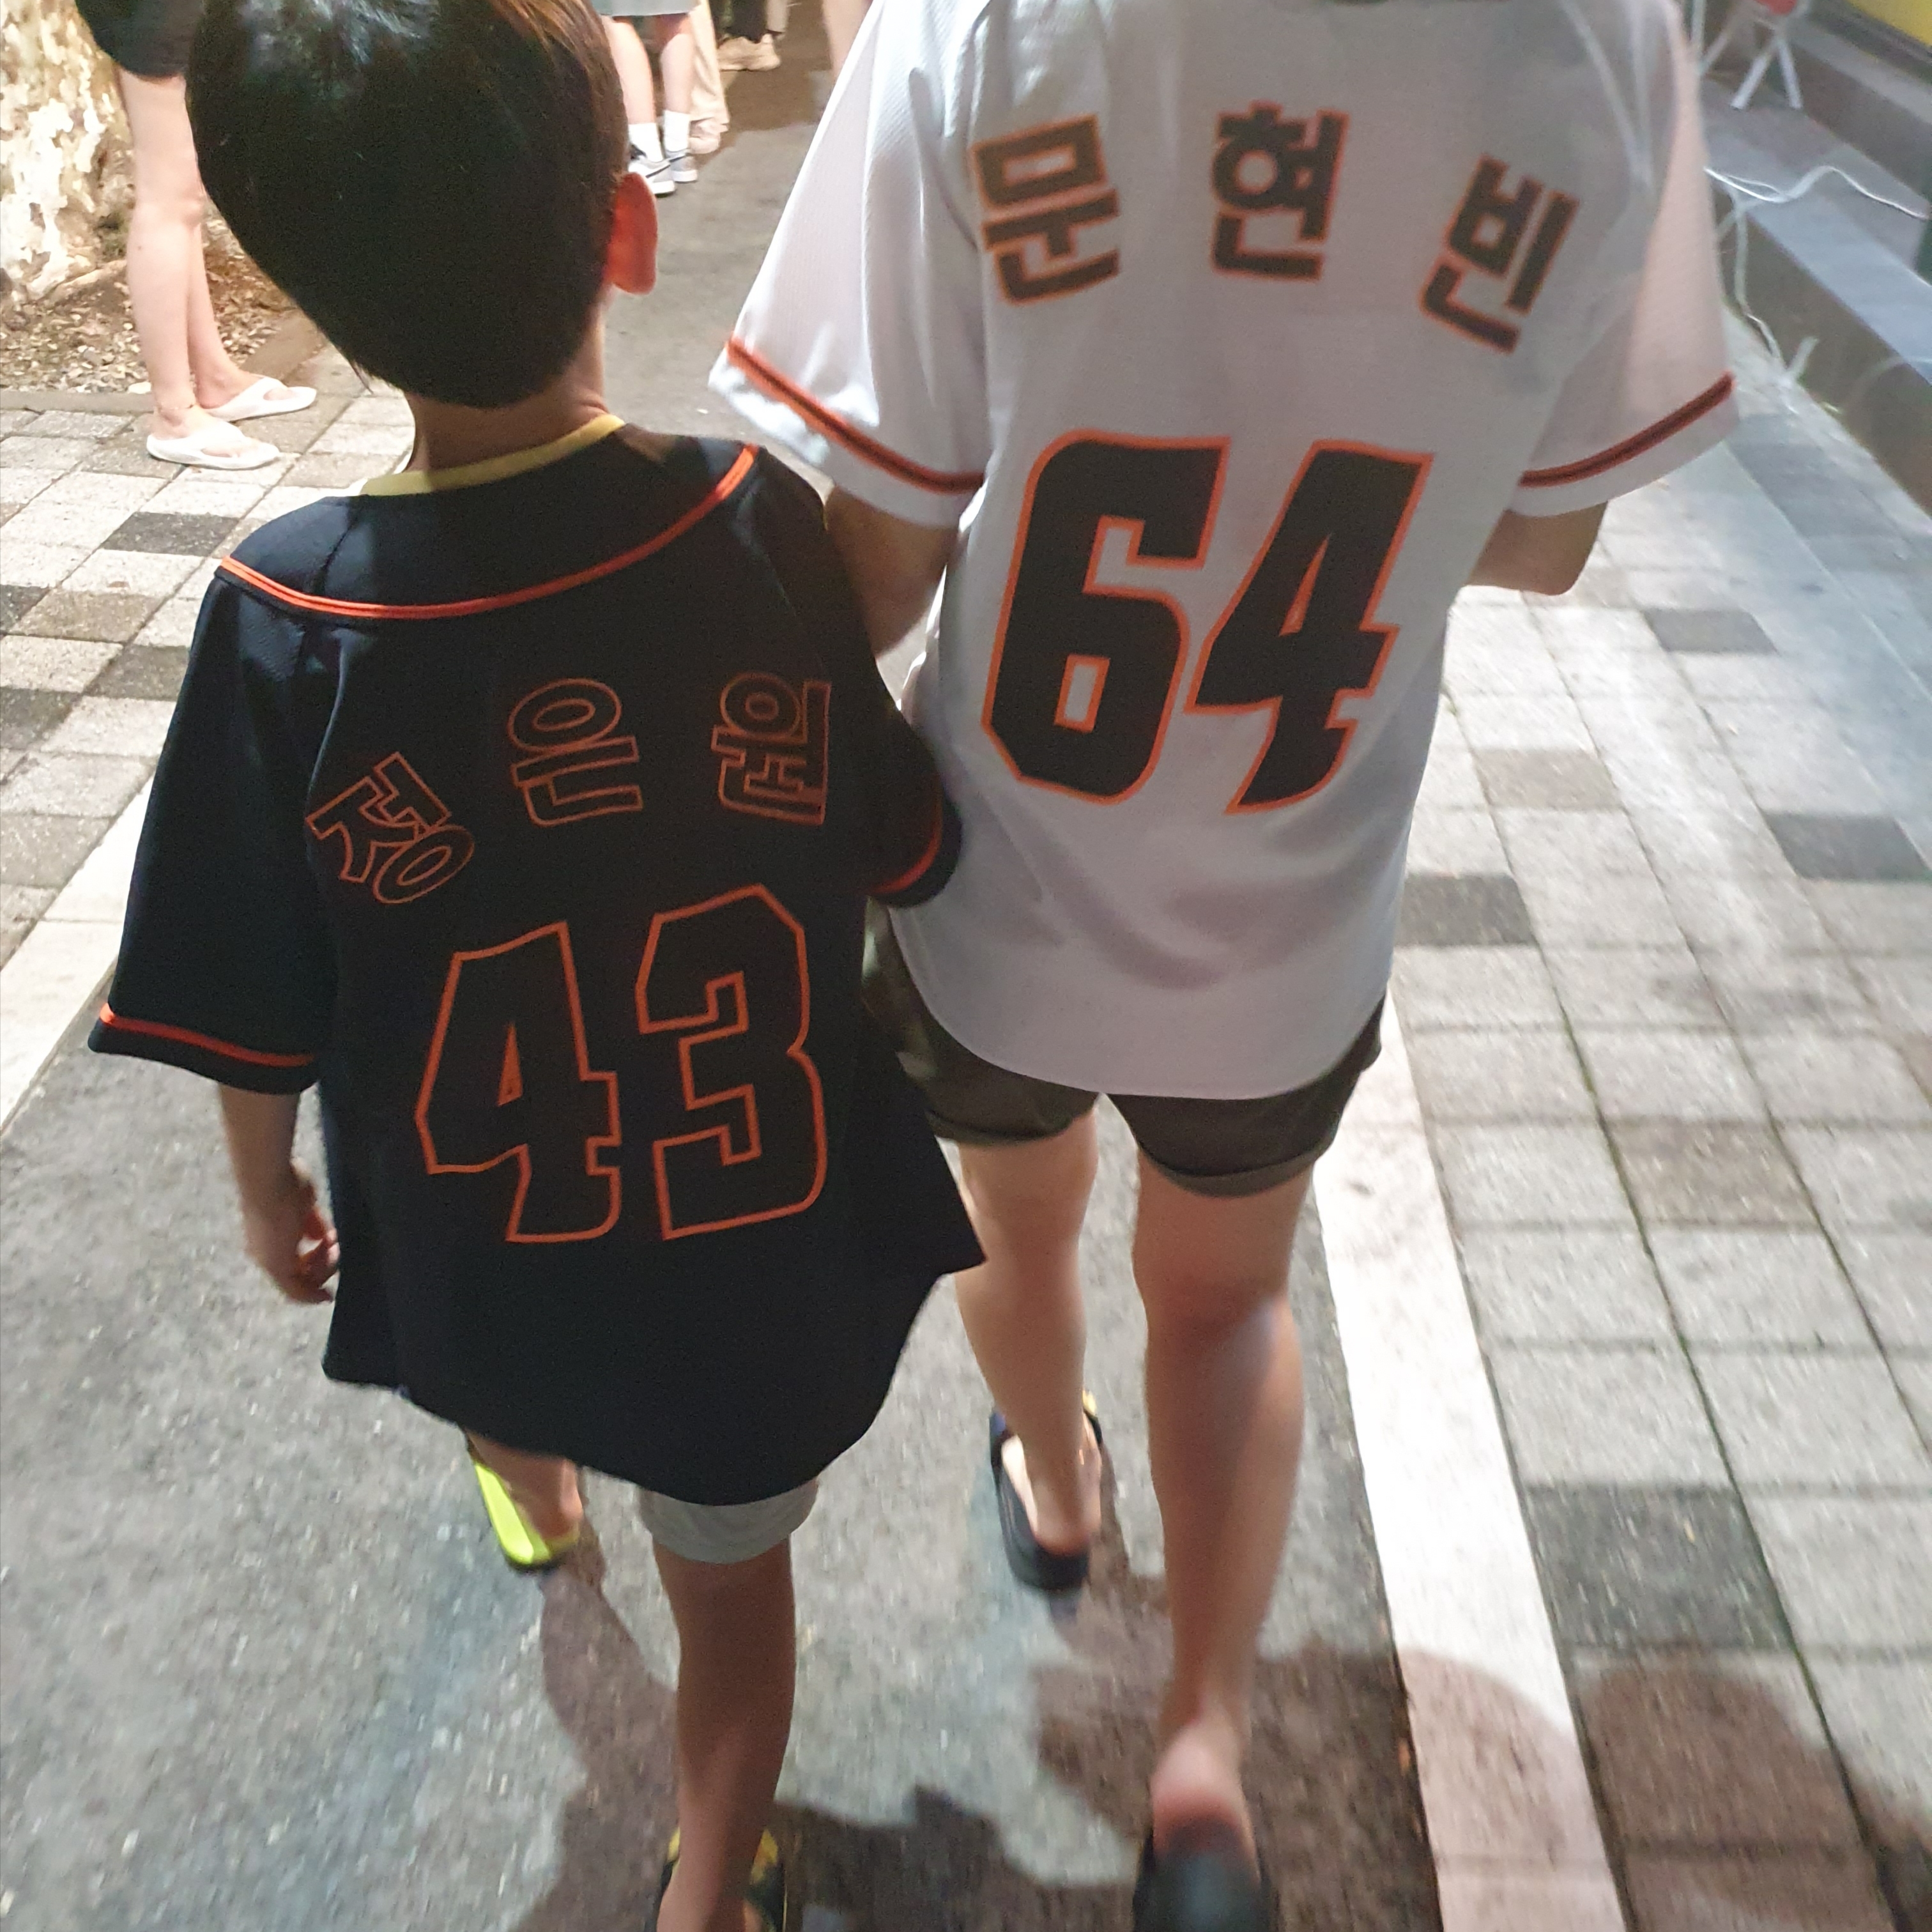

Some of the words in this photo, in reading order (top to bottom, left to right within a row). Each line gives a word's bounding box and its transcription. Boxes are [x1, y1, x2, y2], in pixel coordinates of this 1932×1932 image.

[970, 101, 1579, 354] 문현빈
[981, 427, 1435, 815] 64
[414, 883, 828, 1243] 43
